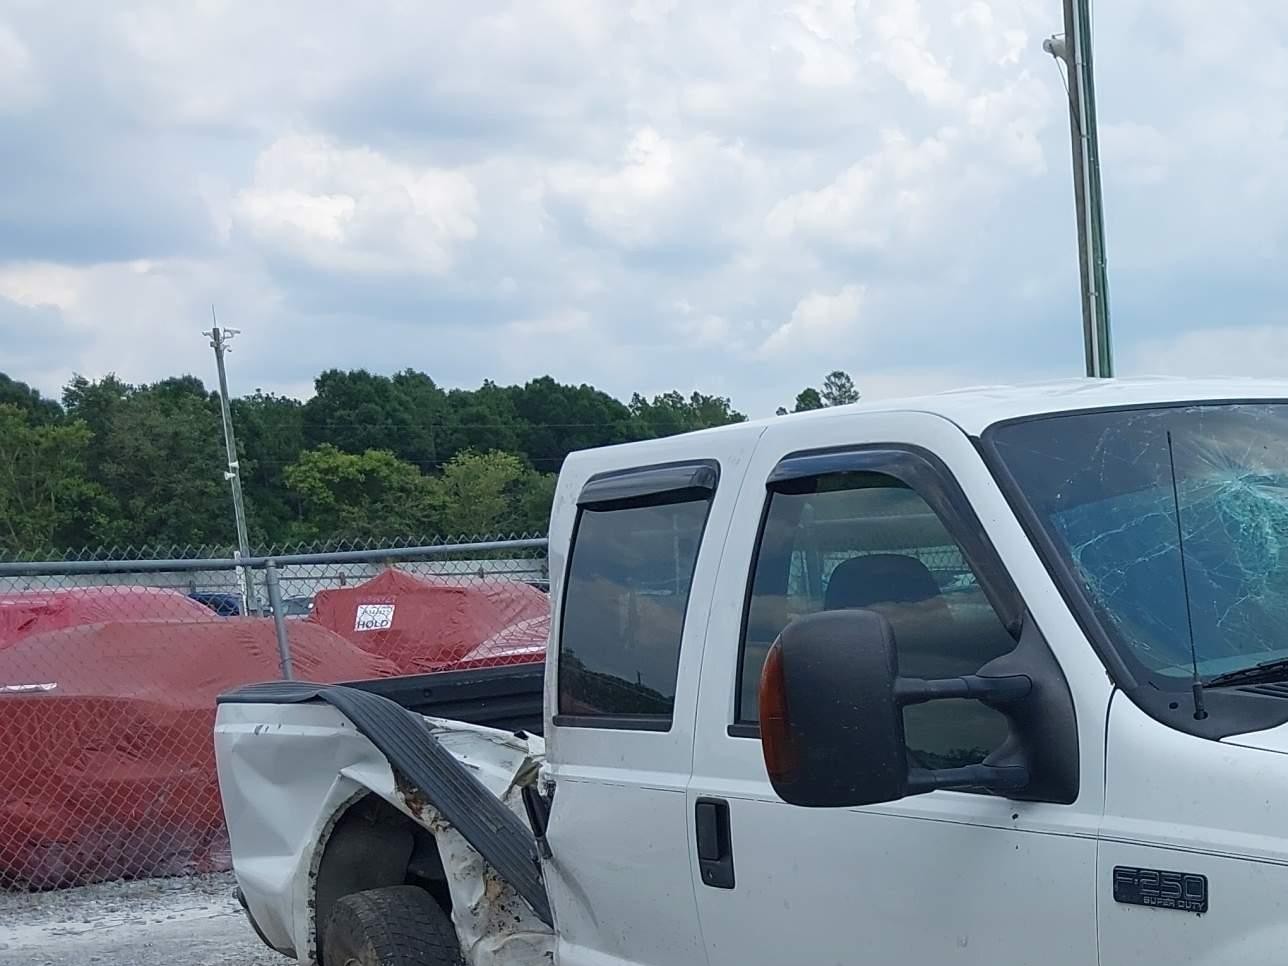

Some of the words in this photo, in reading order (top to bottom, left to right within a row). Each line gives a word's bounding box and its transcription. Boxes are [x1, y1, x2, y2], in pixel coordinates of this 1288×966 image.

[357, 619, 389, 629] HOLD
[1143, 896, 1176, 908] SUPER
[1178, 900, 1205, 910] DUTY
